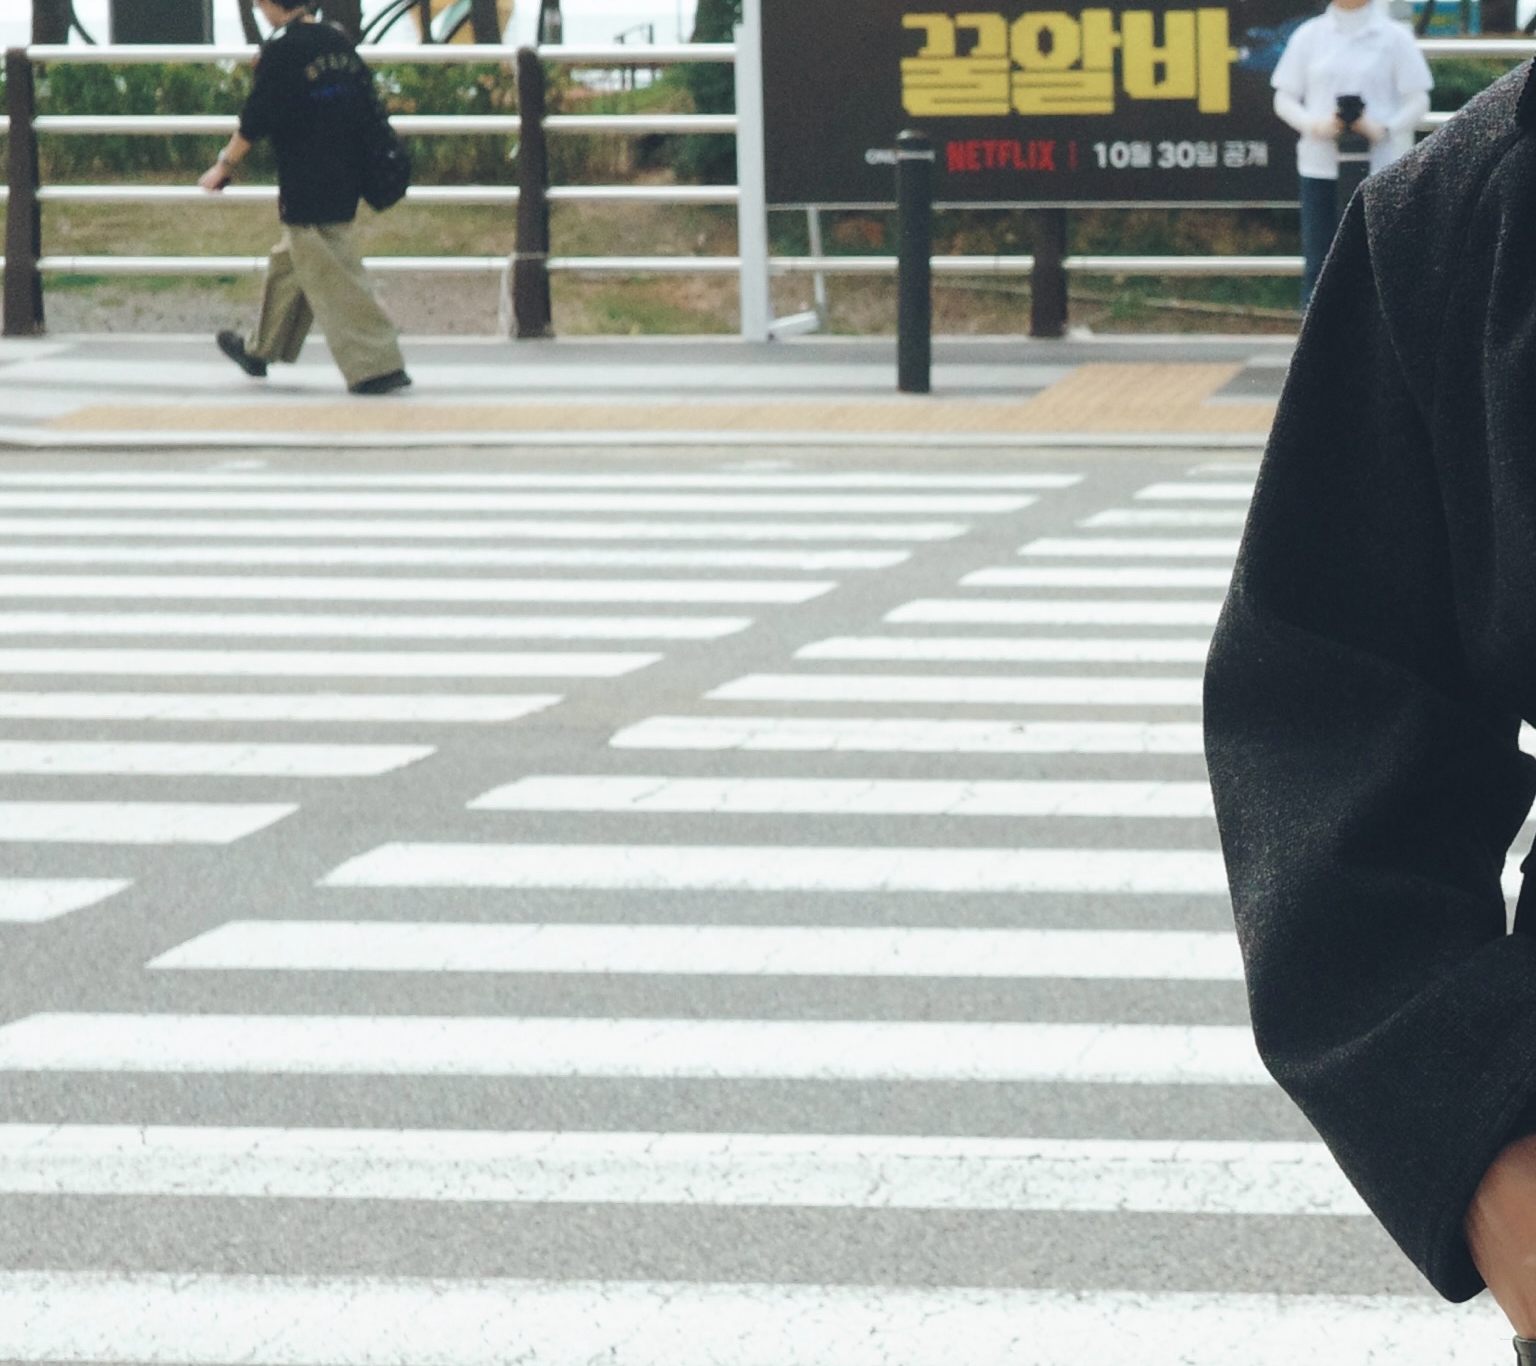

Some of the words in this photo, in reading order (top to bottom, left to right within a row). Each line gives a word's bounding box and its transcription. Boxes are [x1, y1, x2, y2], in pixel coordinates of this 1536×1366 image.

[901, 7, 1238, 116] 꿀알바
[946, 140, 1056, 171] NETFLIX
[1093, 140, 1152, 169] 10월
[1157, 140, 1218, 169] 30일
[1223, 140, 1269, 168] 공개
